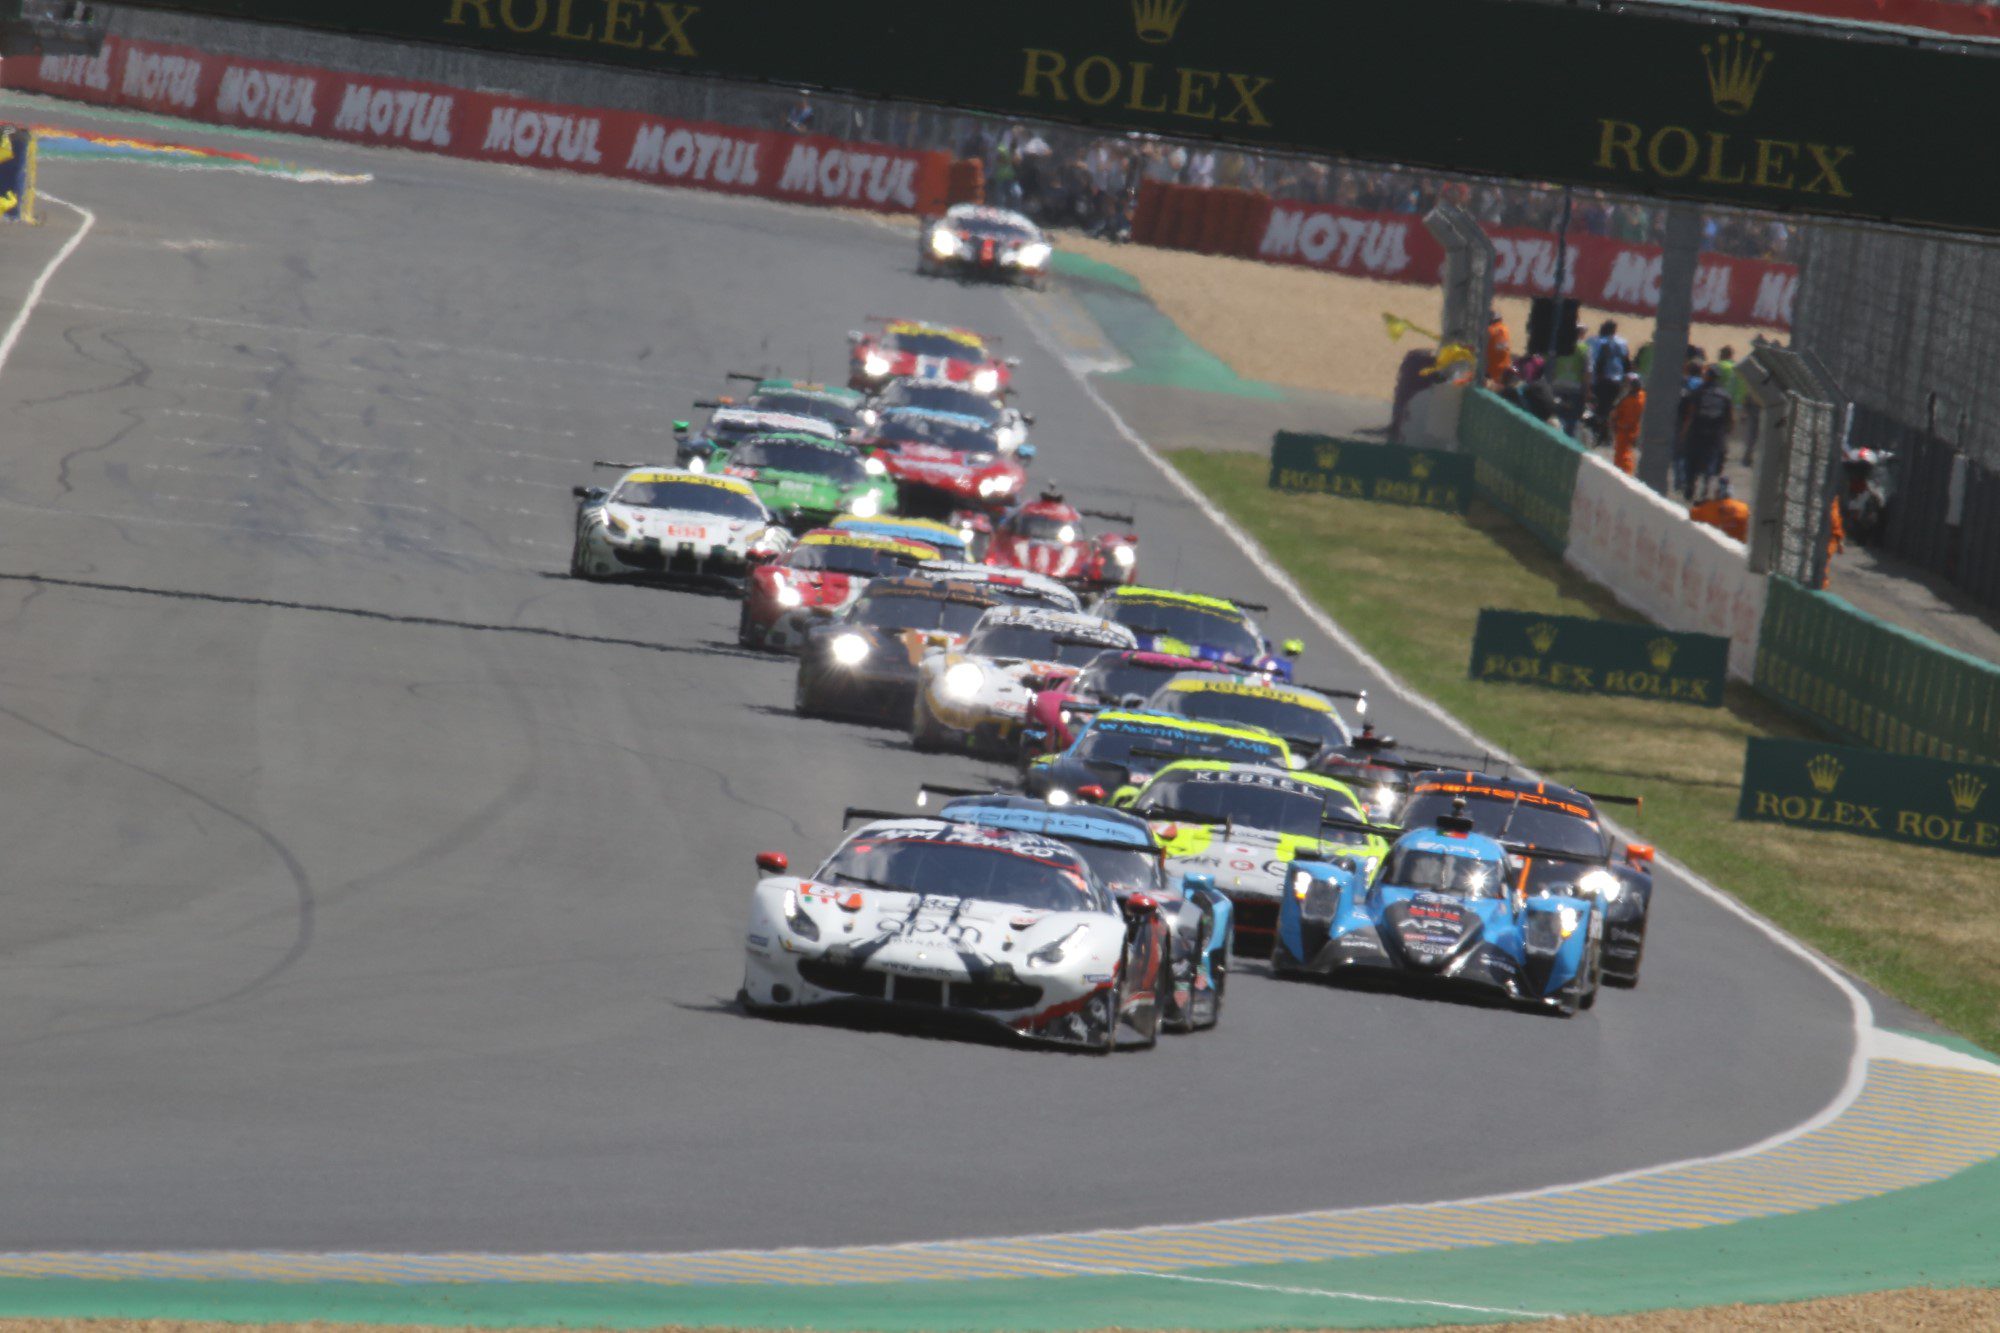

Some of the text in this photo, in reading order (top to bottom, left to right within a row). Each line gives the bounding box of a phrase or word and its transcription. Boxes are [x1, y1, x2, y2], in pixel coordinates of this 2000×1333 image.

[443, 0, 697, 56] ROLEX
[121, 47, 201, 107] MOTUL
[216, 66, 317, 127] MOTUL
[1018, 48, 1272, 127] ROLEX
[334, 82, 455, 146] MOTUL
[482, 106, 602, 164] MOTUL
[626, 122, 760, 187] MOTUL
[780, 144, 918, 202] MOTUL
[1596, 118, 1854, 198] ROLEX
[1261, 207, 1410, 272] MOTUL
[1490, 236, 1579, 296] OTUL
[1483, 655, 1710, 700] ROLEX ROLEX
[1195, 770, 1320, 797] KESSEL
[1755, 790, 2000, 848] ROLEX ROLE
